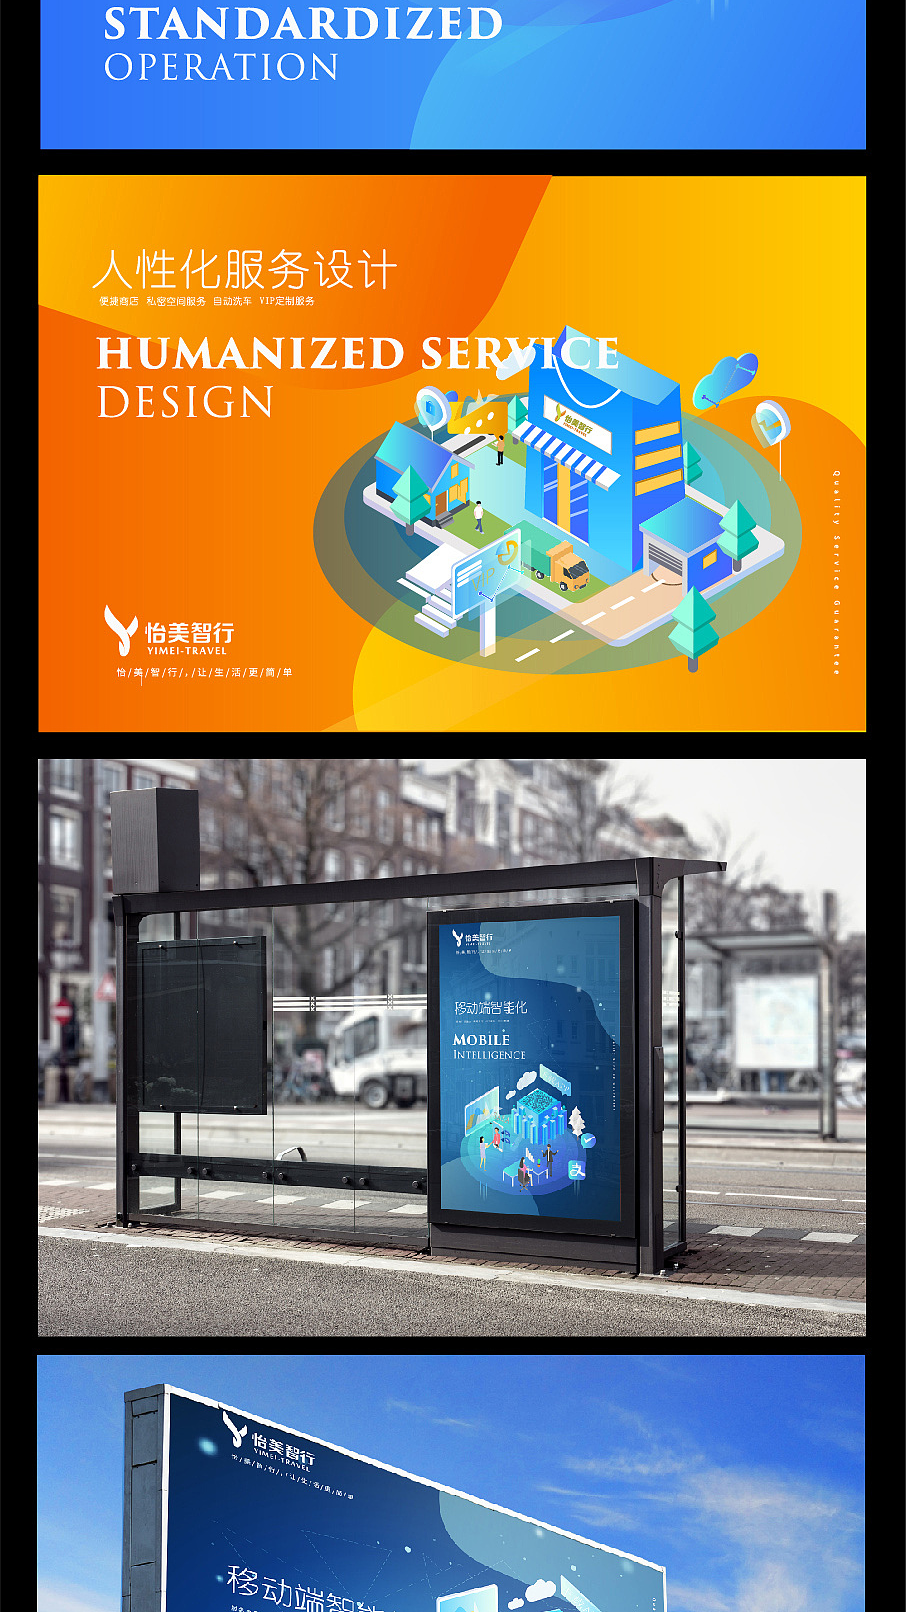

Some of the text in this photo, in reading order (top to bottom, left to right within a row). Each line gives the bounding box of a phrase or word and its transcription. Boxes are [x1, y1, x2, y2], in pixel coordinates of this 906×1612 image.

[104, 6, 503, 40] STANDARDIZED
[104, 52, 338, 81] OPERATION
[92, 248, 398, 290] 人性化服务设计
[99, 296, 315, 306] 便捷商店 私密空间服务 自动洗车 VIP定制服务
[96, 337, 619, 370] HUMANIZED SERVICE
[97, 385, 274, 419] DESIGN
[472, 568, 495, 591] VIP
[832, 471, 841, 674] Quality Service Guarantee
[145, 622, 234, 644] 怡美智行
[147, 646, 227, 655] YIMEI-TRAVEL
